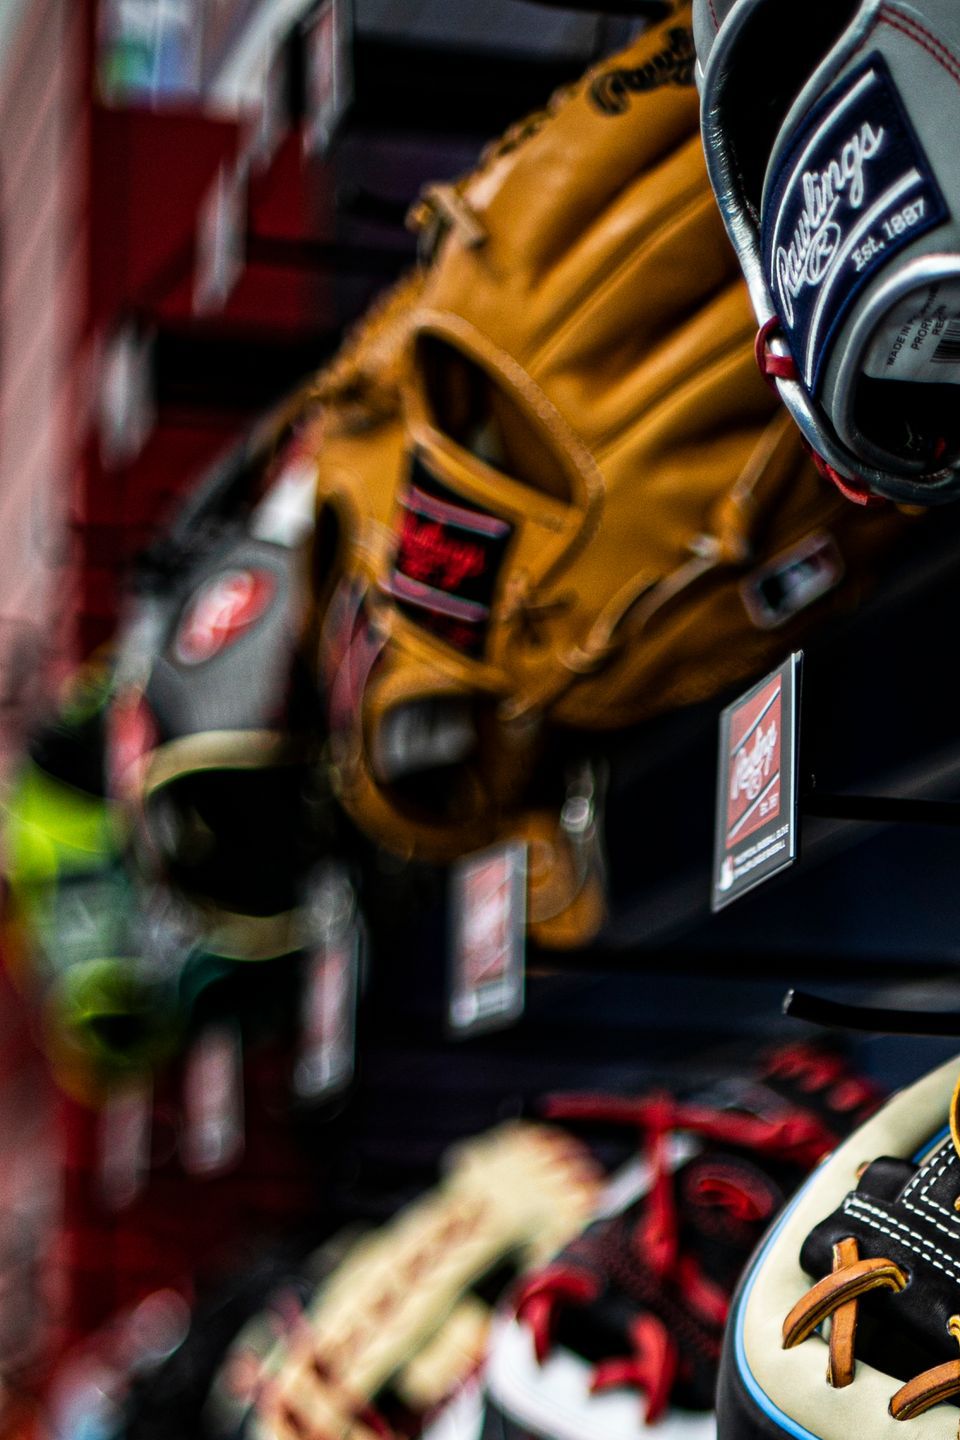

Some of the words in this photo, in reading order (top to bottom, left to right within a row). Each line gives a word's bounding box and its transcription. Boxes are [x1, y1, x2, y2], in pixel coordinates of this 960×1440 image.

[776, 121, 884, 330] Rawlings
[851, 236, 886, 272] Est.
[882, 198, 926, 240] 1887
[886, 336, 906, 367] MADE
[900, 325, 912, 337] IN
